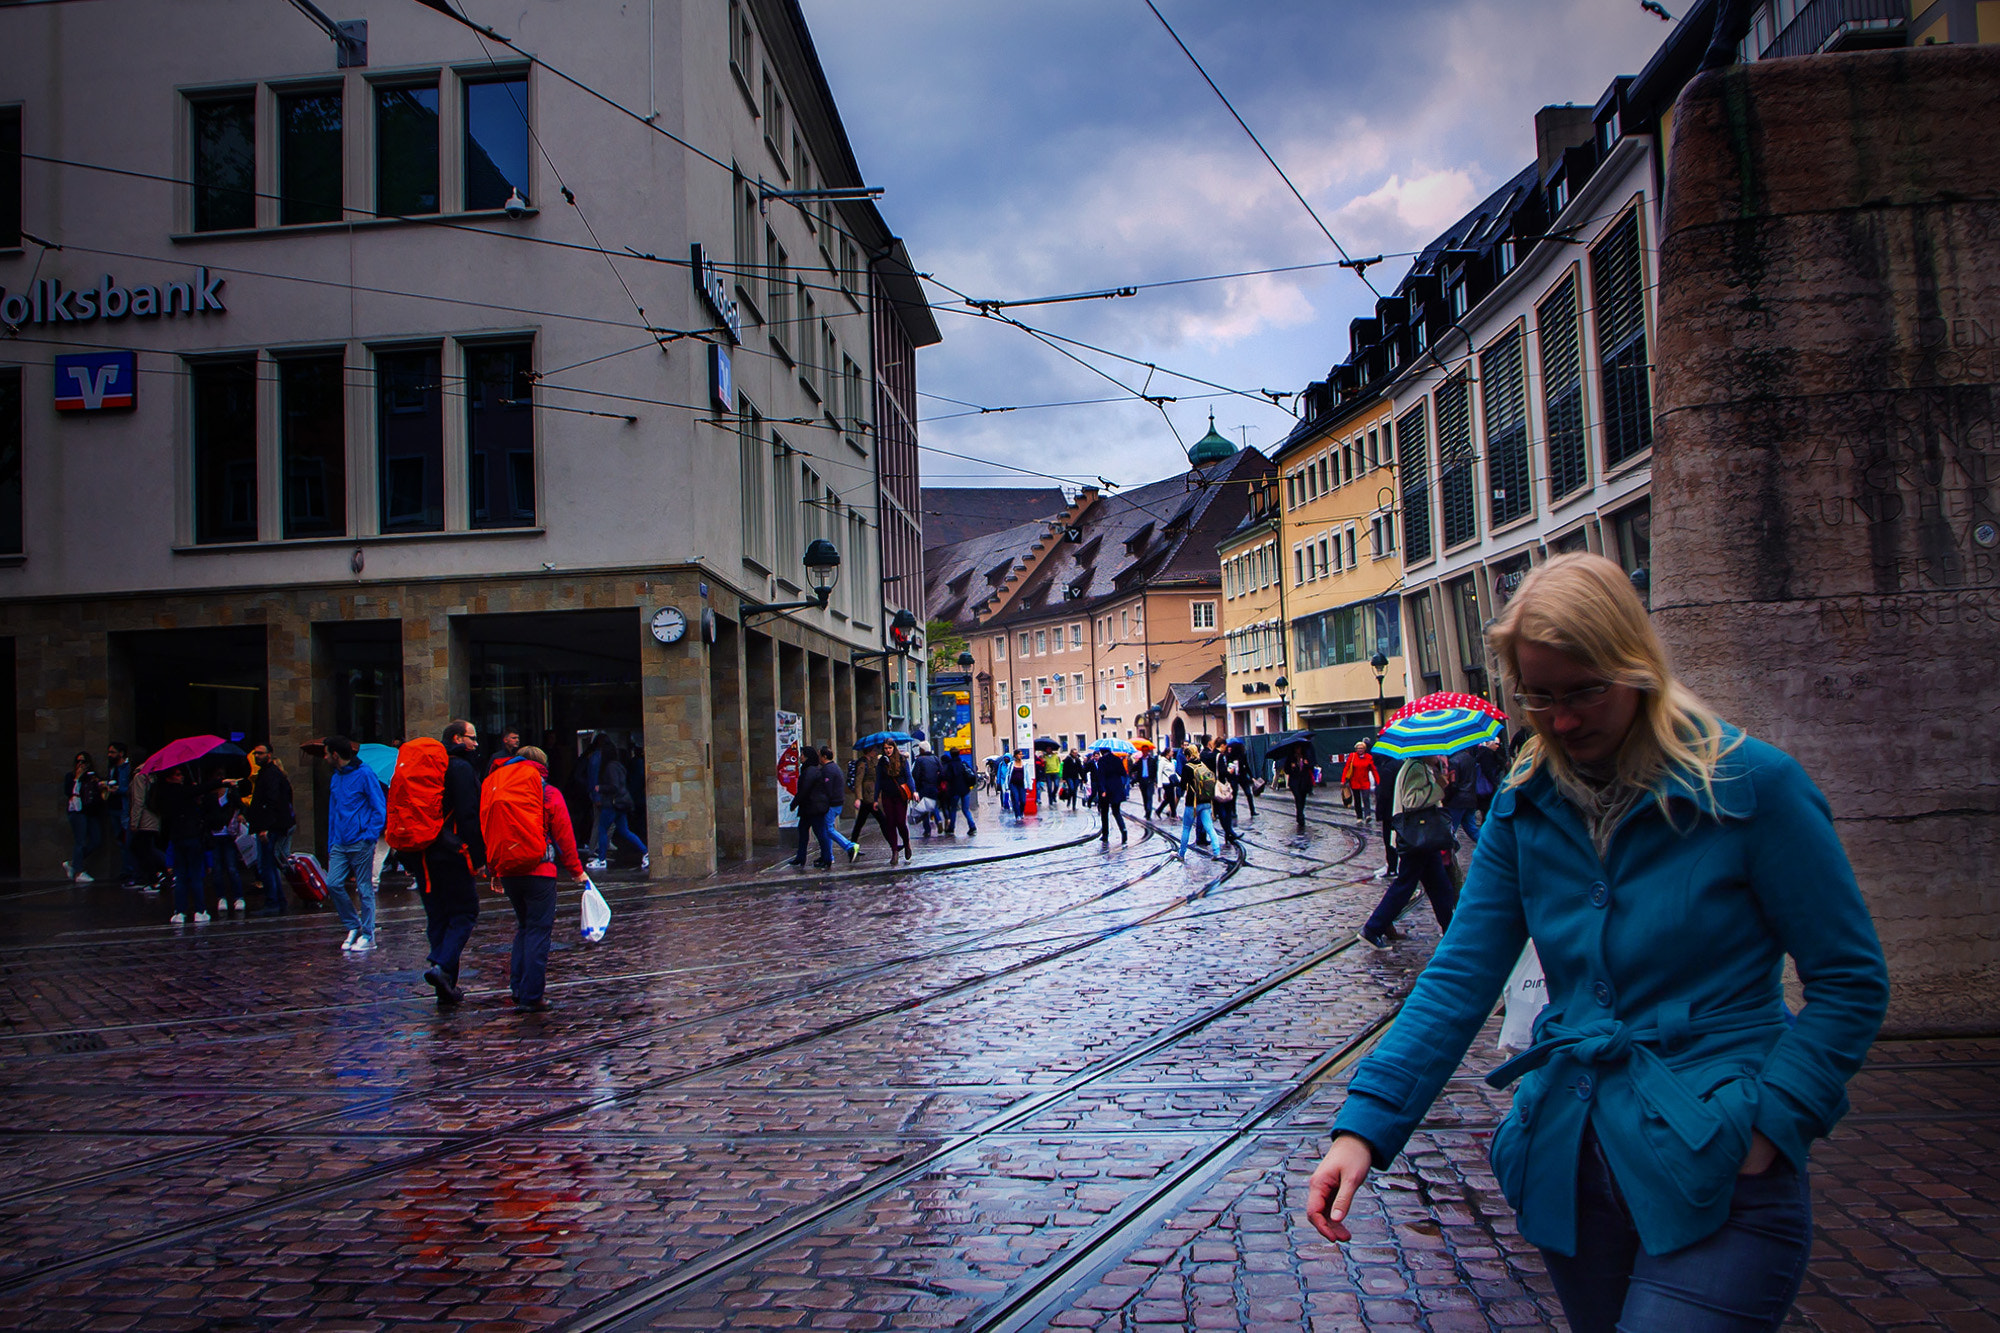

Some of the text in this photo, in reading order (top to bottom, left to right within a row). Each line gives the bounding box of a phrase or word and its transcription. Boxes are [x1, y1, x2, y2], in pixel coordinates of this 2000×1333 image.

[0, 266, 225, 328] olksbank
[1910, 316, 1998, 351] DEN
[1818, 491, 1904, 527] UND
[1894, 551, 2000, 592] FREIB
[1819, 595, 1867, 633] IM
